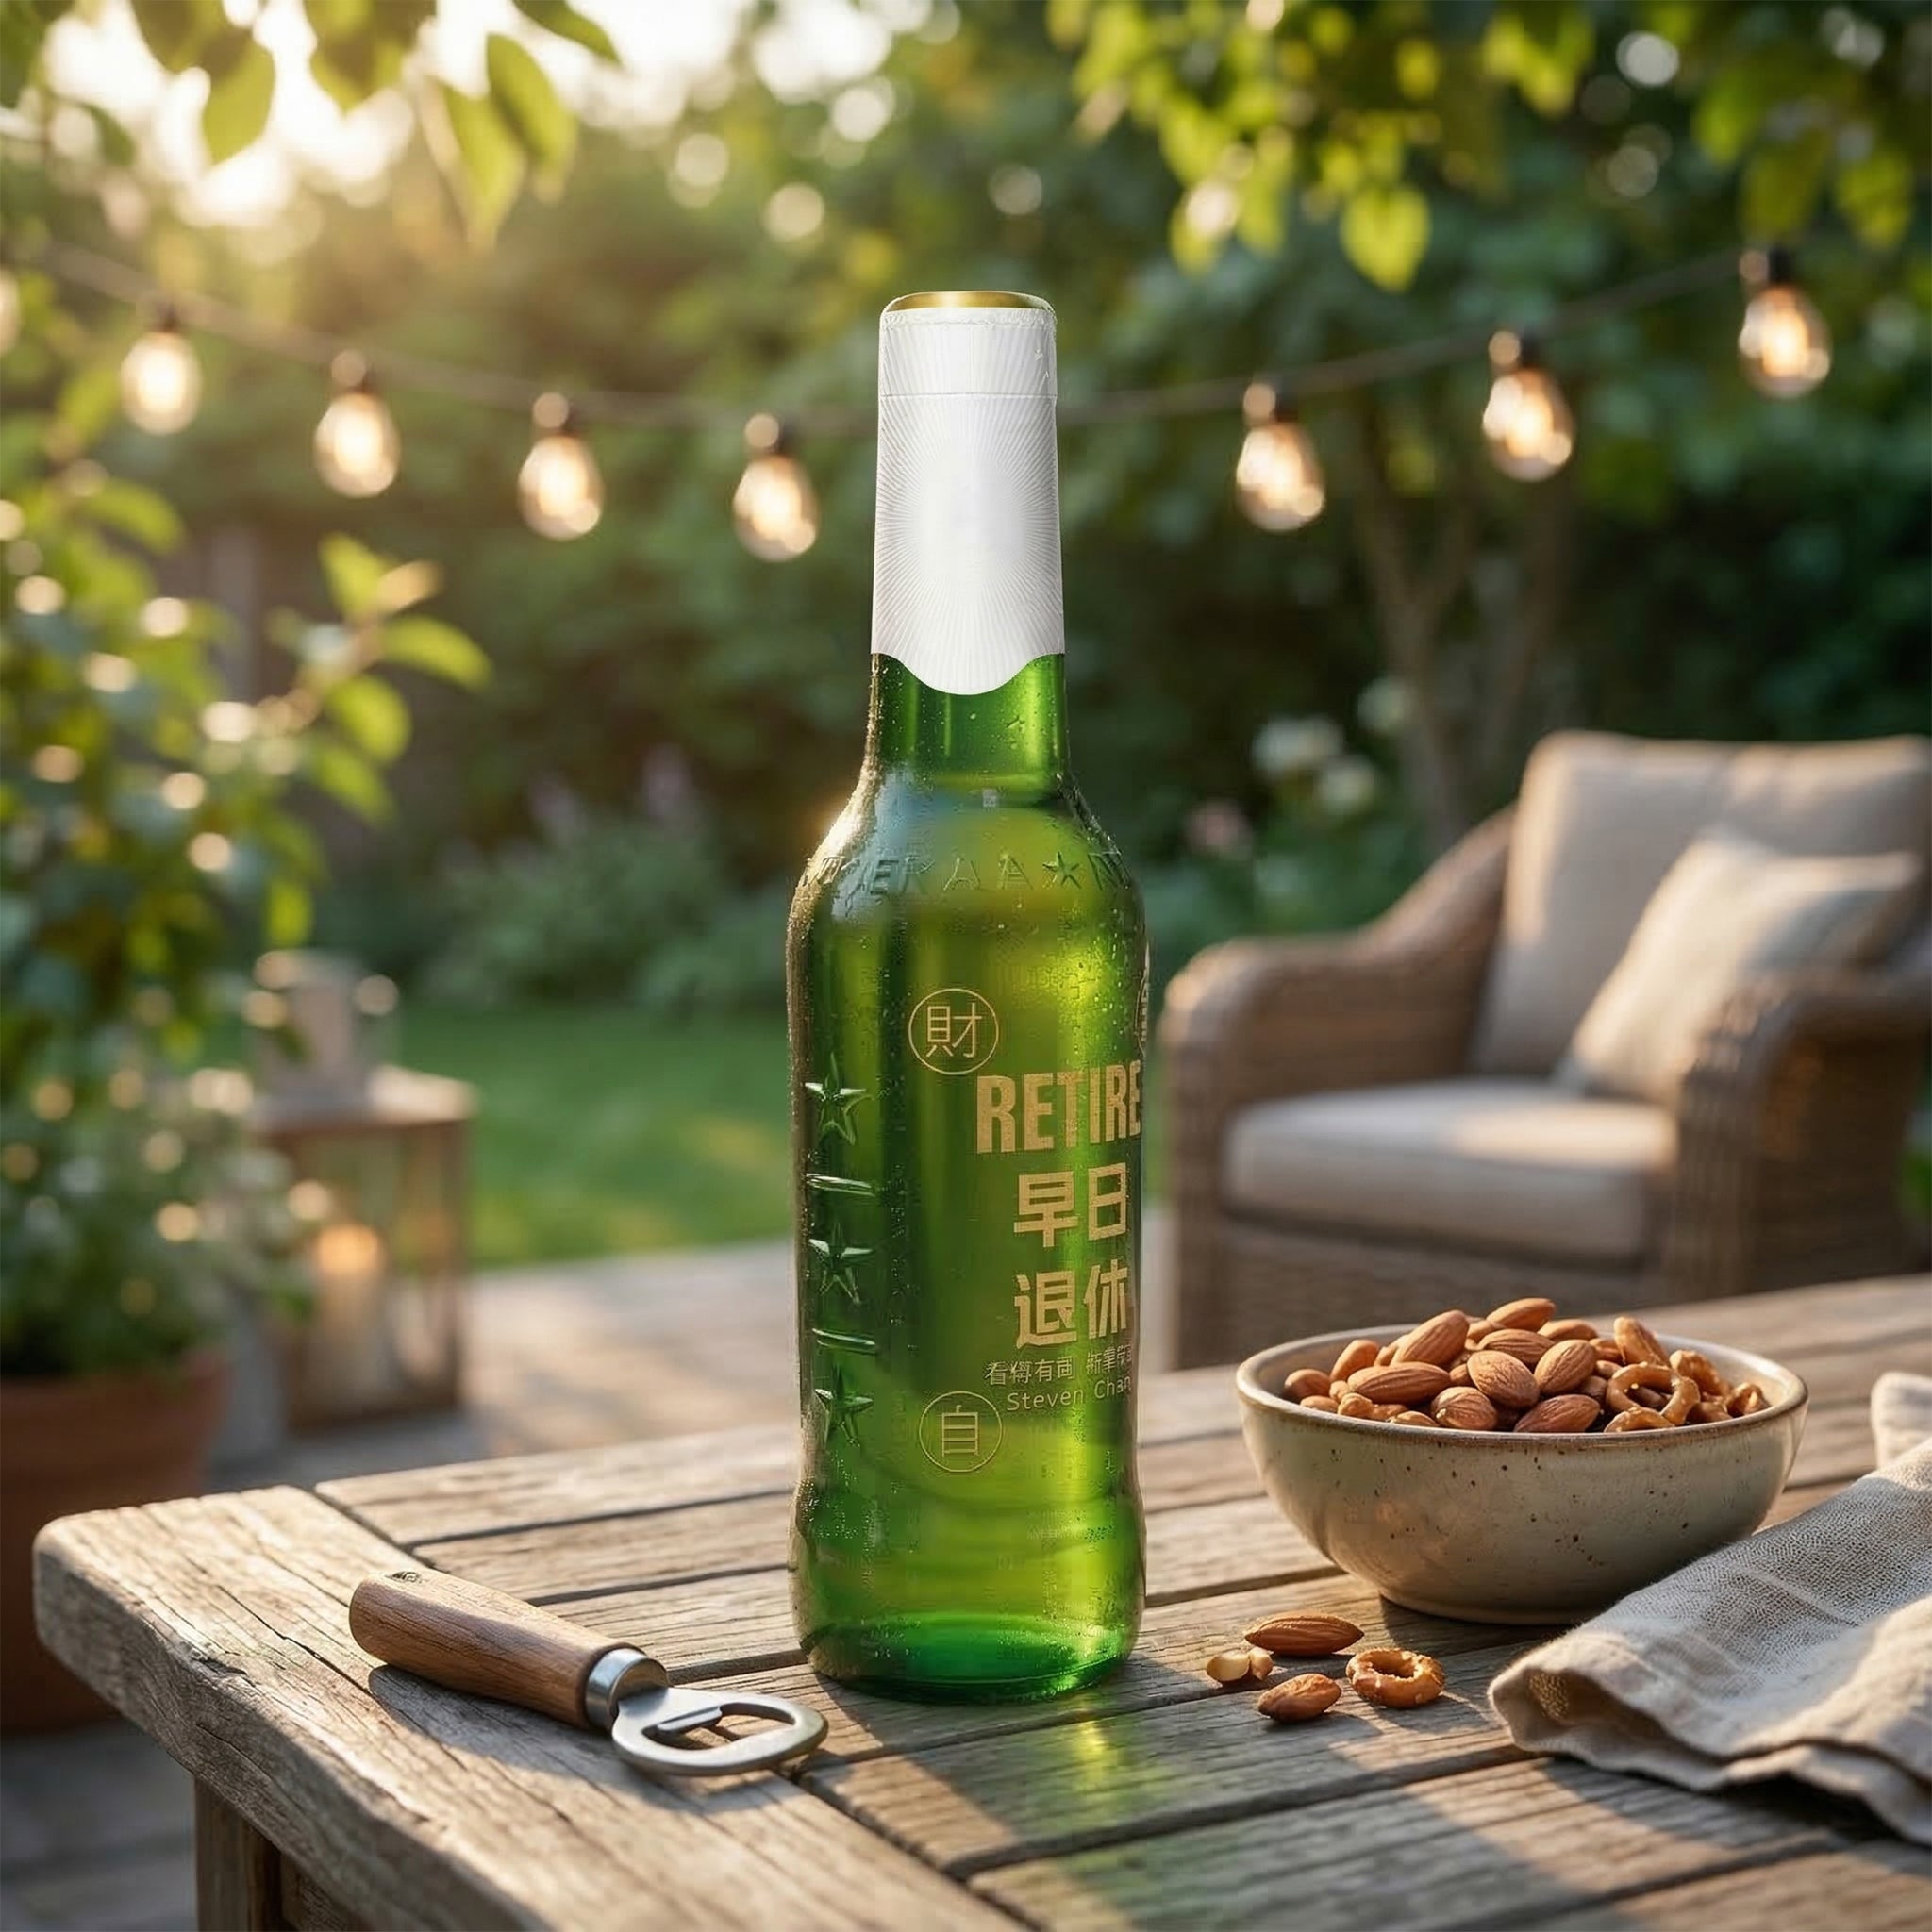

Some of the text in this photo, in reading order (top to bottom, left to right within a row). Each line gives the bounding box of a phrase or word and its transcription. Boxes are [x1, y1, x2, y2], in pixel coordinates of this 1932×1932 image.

[925, 1003, 982, 1058] 財
[977, 1059, 1141, 1154] RETIRE
[1014, 1162, 1126, 1247] 早日
[1014, 1259, 1128, 1349] 退休
[941, 1405, 979, 1456] 自
[1007, 1389, 1084, 1411] Steven
